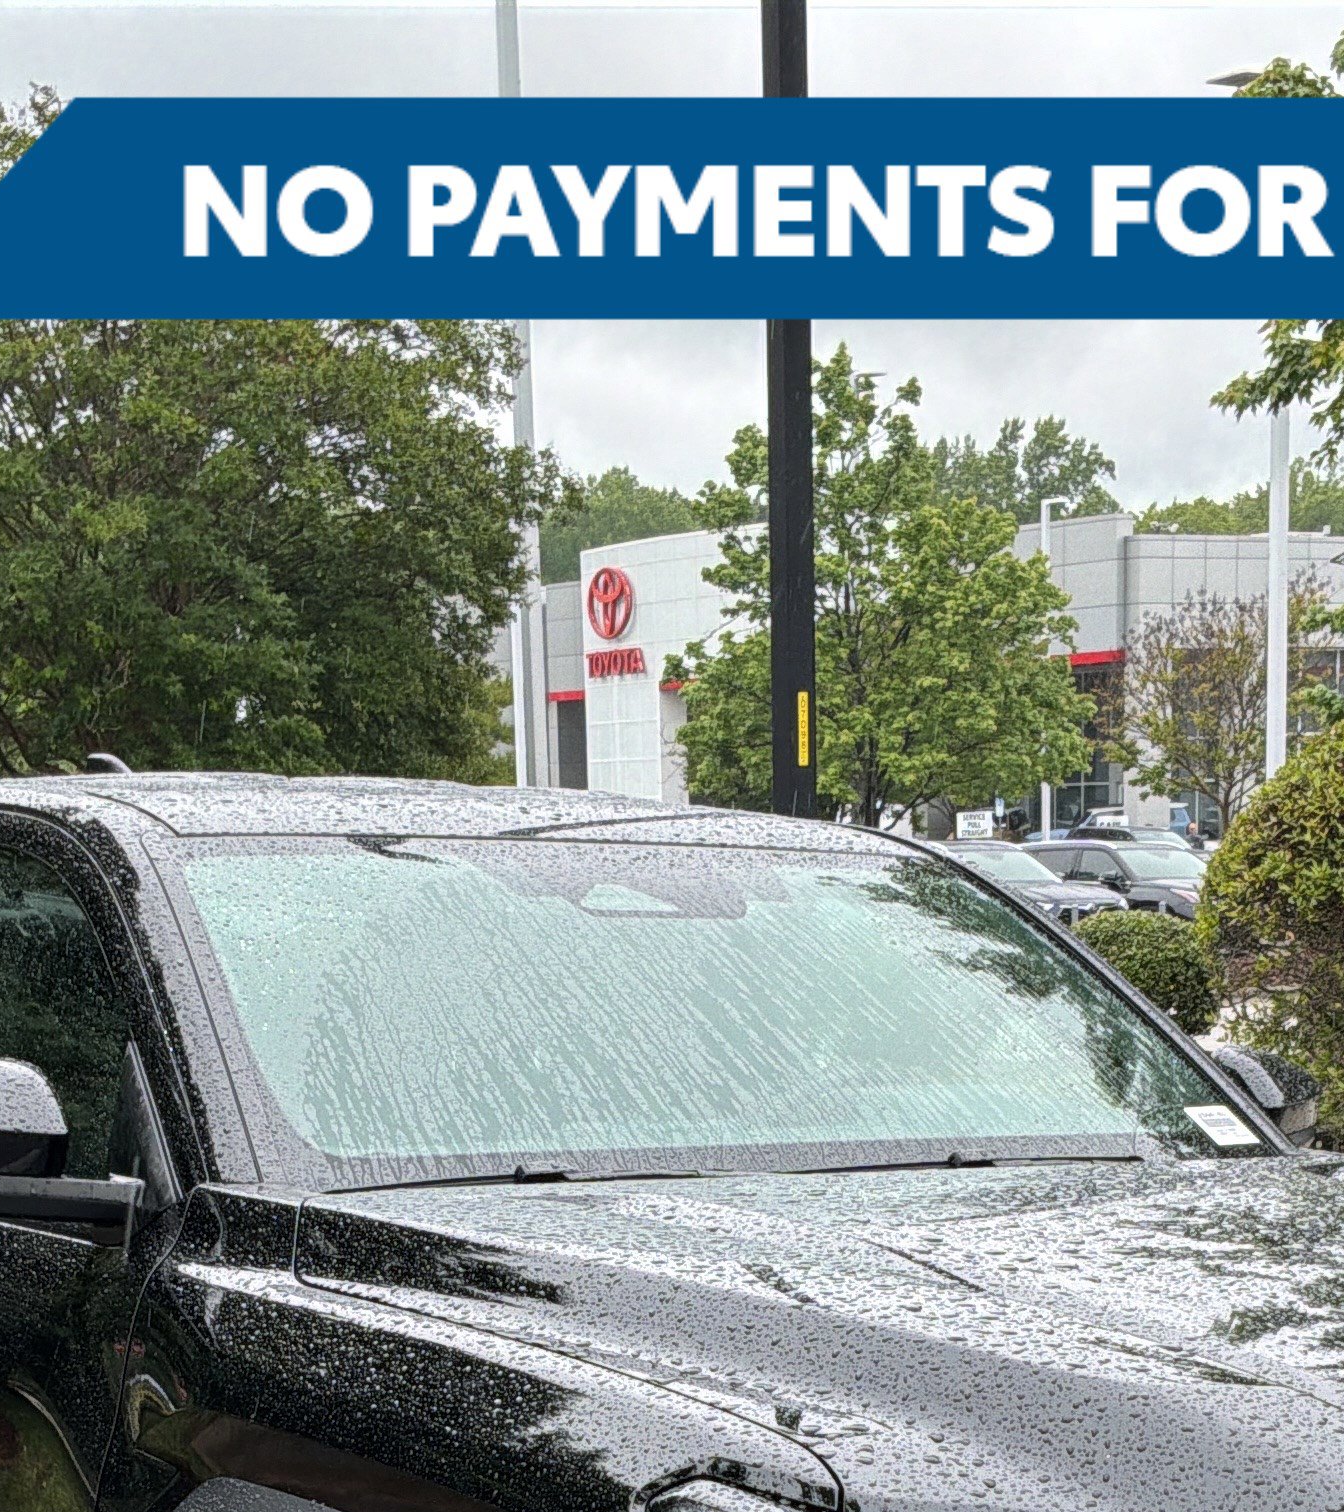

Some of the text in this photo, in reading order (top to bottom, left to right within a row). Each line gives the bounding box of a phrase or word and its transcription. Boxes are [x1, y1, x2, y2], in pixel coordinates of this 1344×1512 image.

[586, 647, 646, 678] TOYOTA
[962, 813, 986, 821] SERVICE
[967, 821, 981, 829] PULL
[961, 828, 988, 838] STRAIGHT
